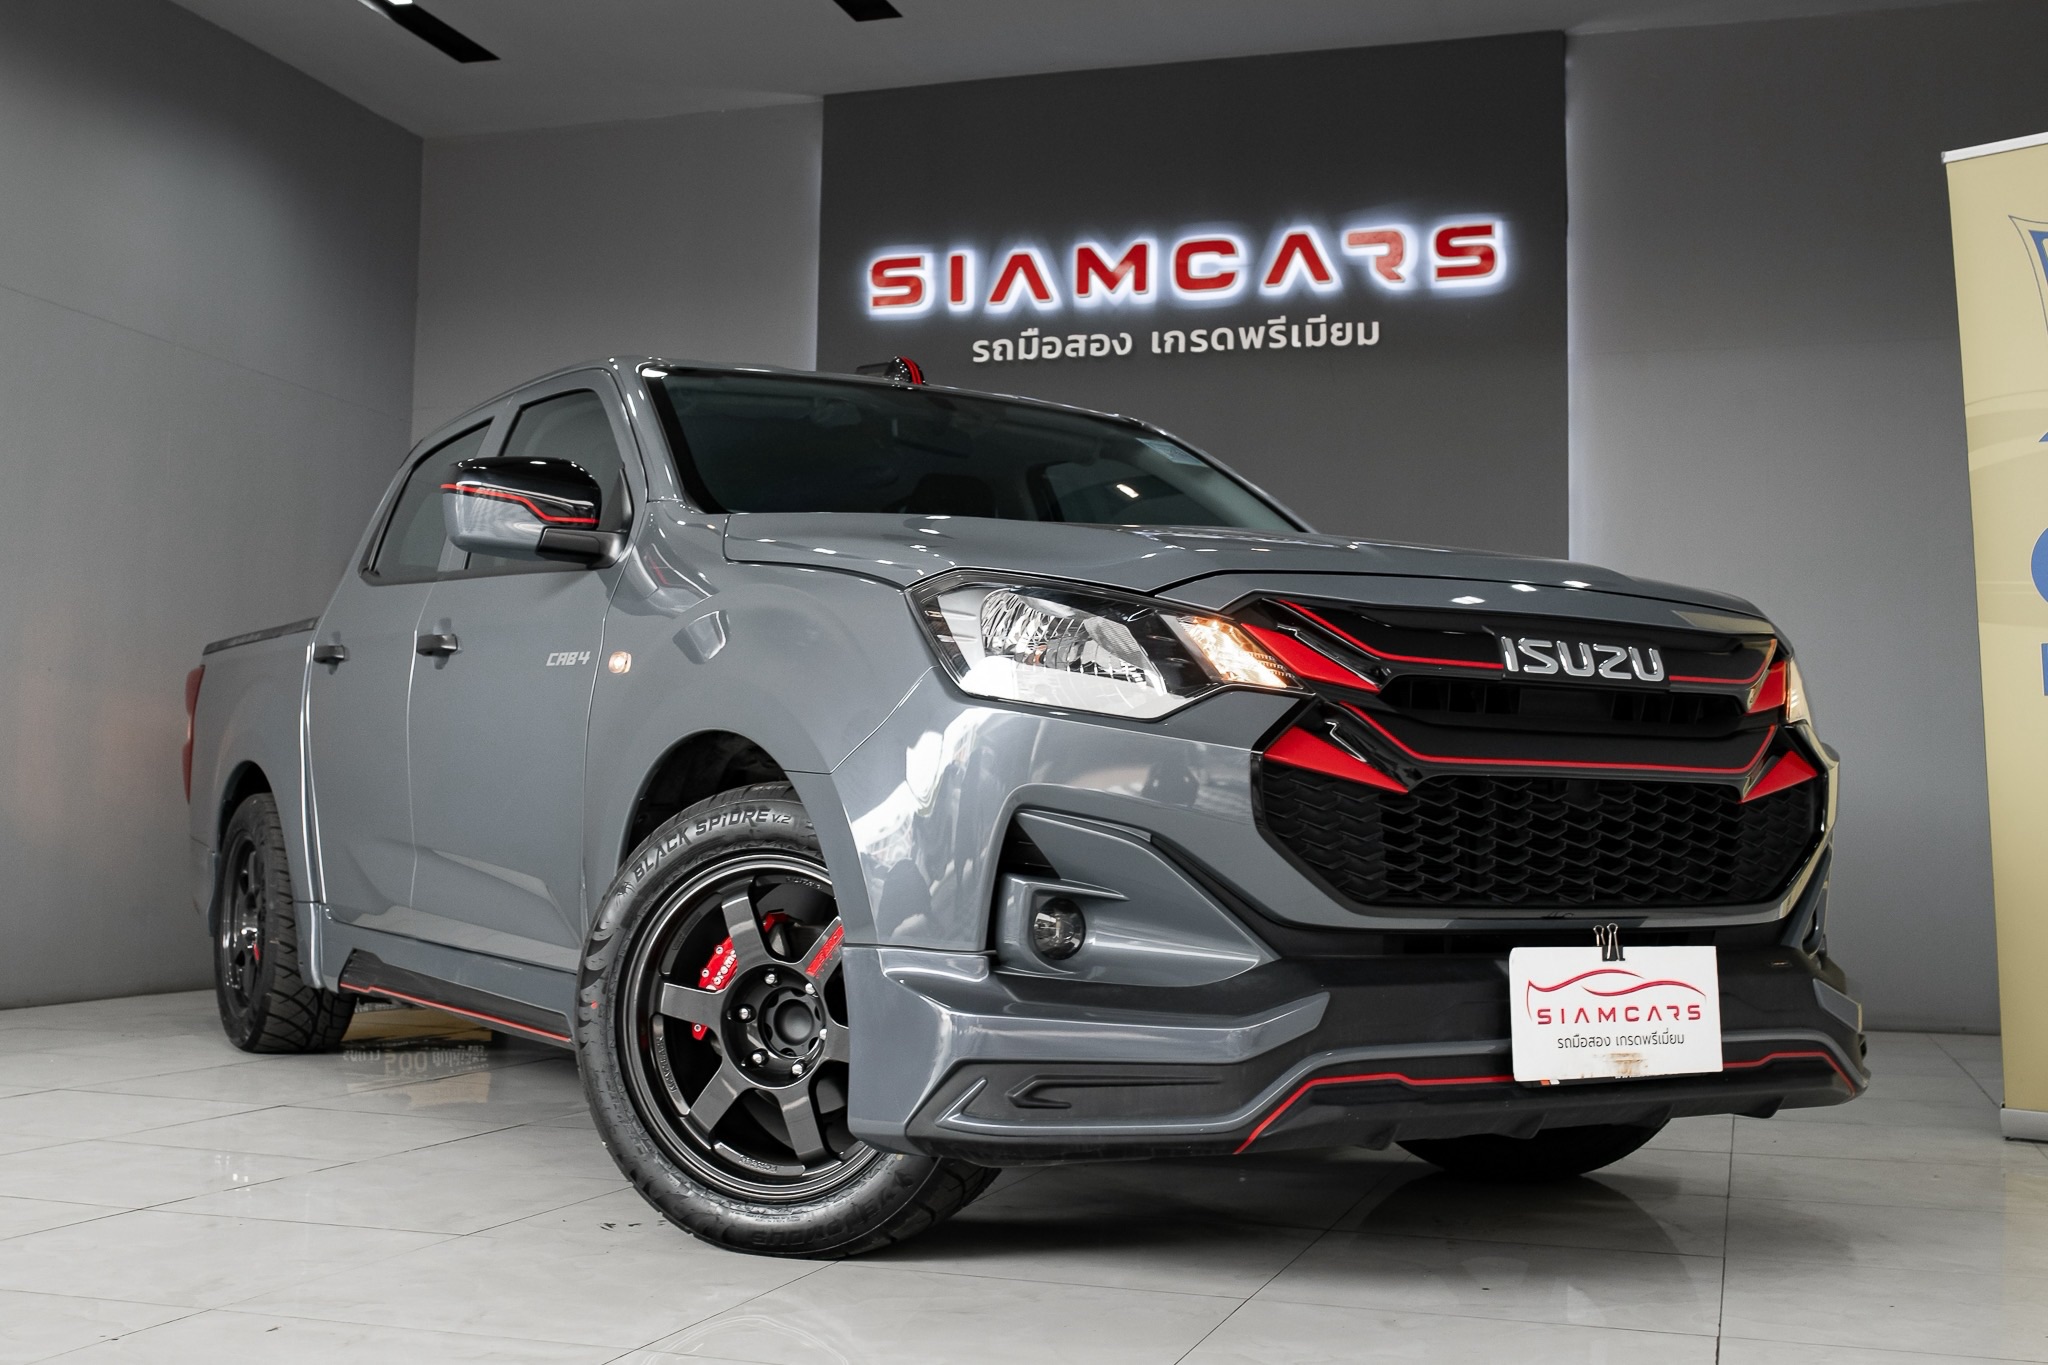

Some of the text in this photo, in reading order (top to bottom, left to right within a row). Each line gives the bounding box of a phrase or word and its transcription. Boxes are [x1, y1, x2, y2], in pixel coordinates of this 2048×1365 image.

[868, 221, 1498, 309] SIAMCARS
[972, 314, 1380, 363] รถมือสอง เกรดพรีเมียม
[546, 651, 591, 667] CAB4
[1501, 636, 1665, 682] ISUZU
[633, 827, 692, 882] BLACK
[1537, 1004, 1702, 1025] SIAMCARS
[1557, 1033, 1611, 1049] รถมือสอง
